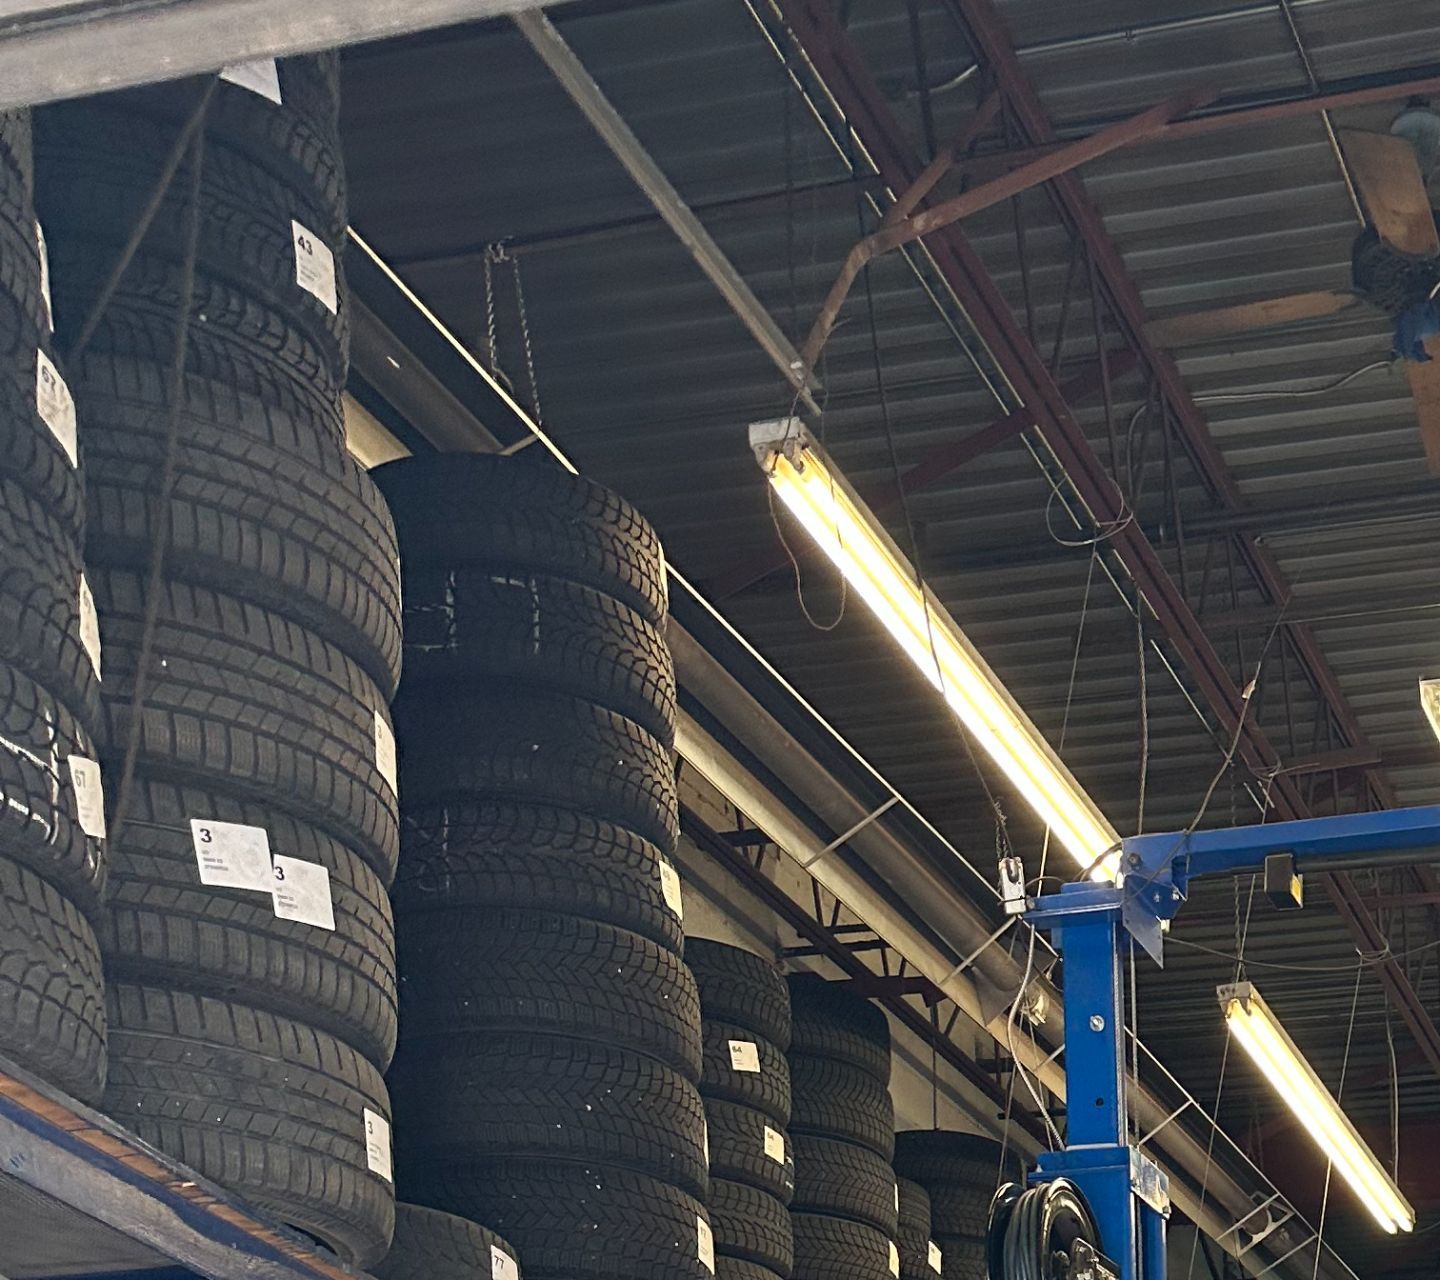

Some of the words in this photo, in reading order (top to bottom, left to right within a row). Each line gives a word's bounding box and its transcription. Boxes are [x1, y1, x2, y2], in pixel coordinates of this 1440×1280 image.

[297, 233, 313, 256] 43
[199, 828, 212, 844] 3
[274, 866, 285, 882] 3
[367, 1120, 374, 1135] 3
[493, 1254, 505, 1270] 77
